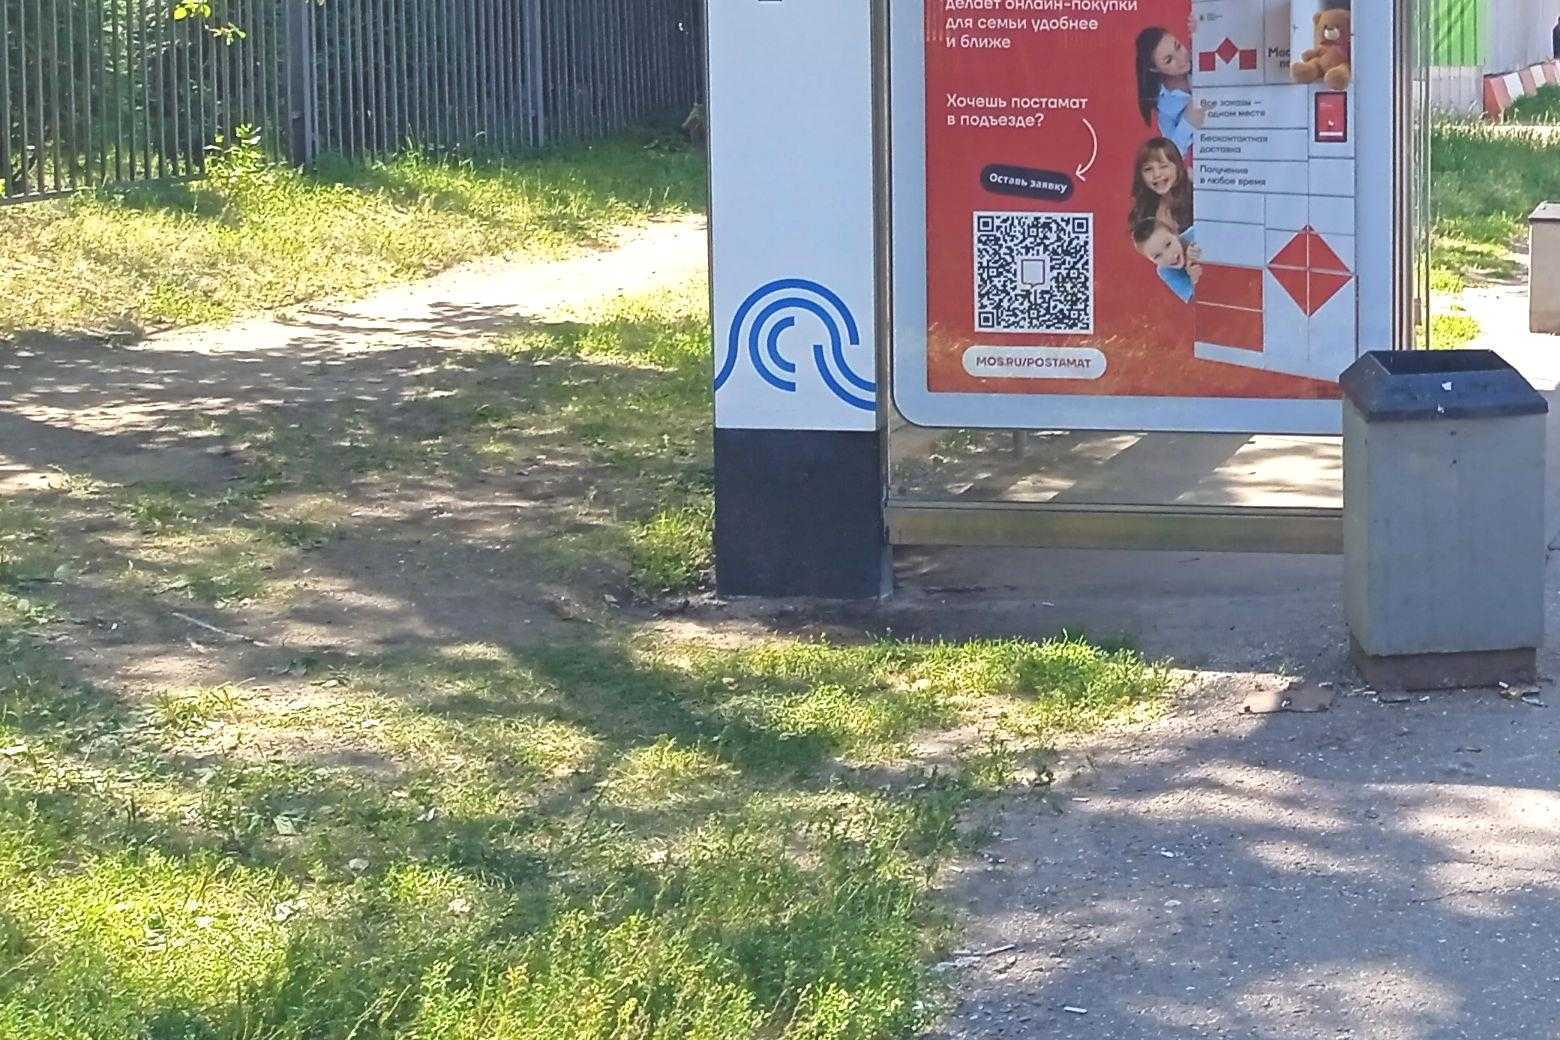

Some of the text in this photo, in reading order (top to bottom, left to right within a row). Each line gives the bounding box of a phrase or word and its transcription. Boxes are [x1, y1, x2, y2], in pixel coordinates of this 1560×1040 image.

[945, 16, 1098, 32] для семьи удобнее
[945, 34, 1011, 49] и ближе
[946, 93, 1088, 109] Хочешь постамат
[947, 113, 1044, 128] в подъезде?
[989, 172, 1068, 195] Оставь заявку
[976, 356, 1092, 369] MOS.RU/POSTAMAT
